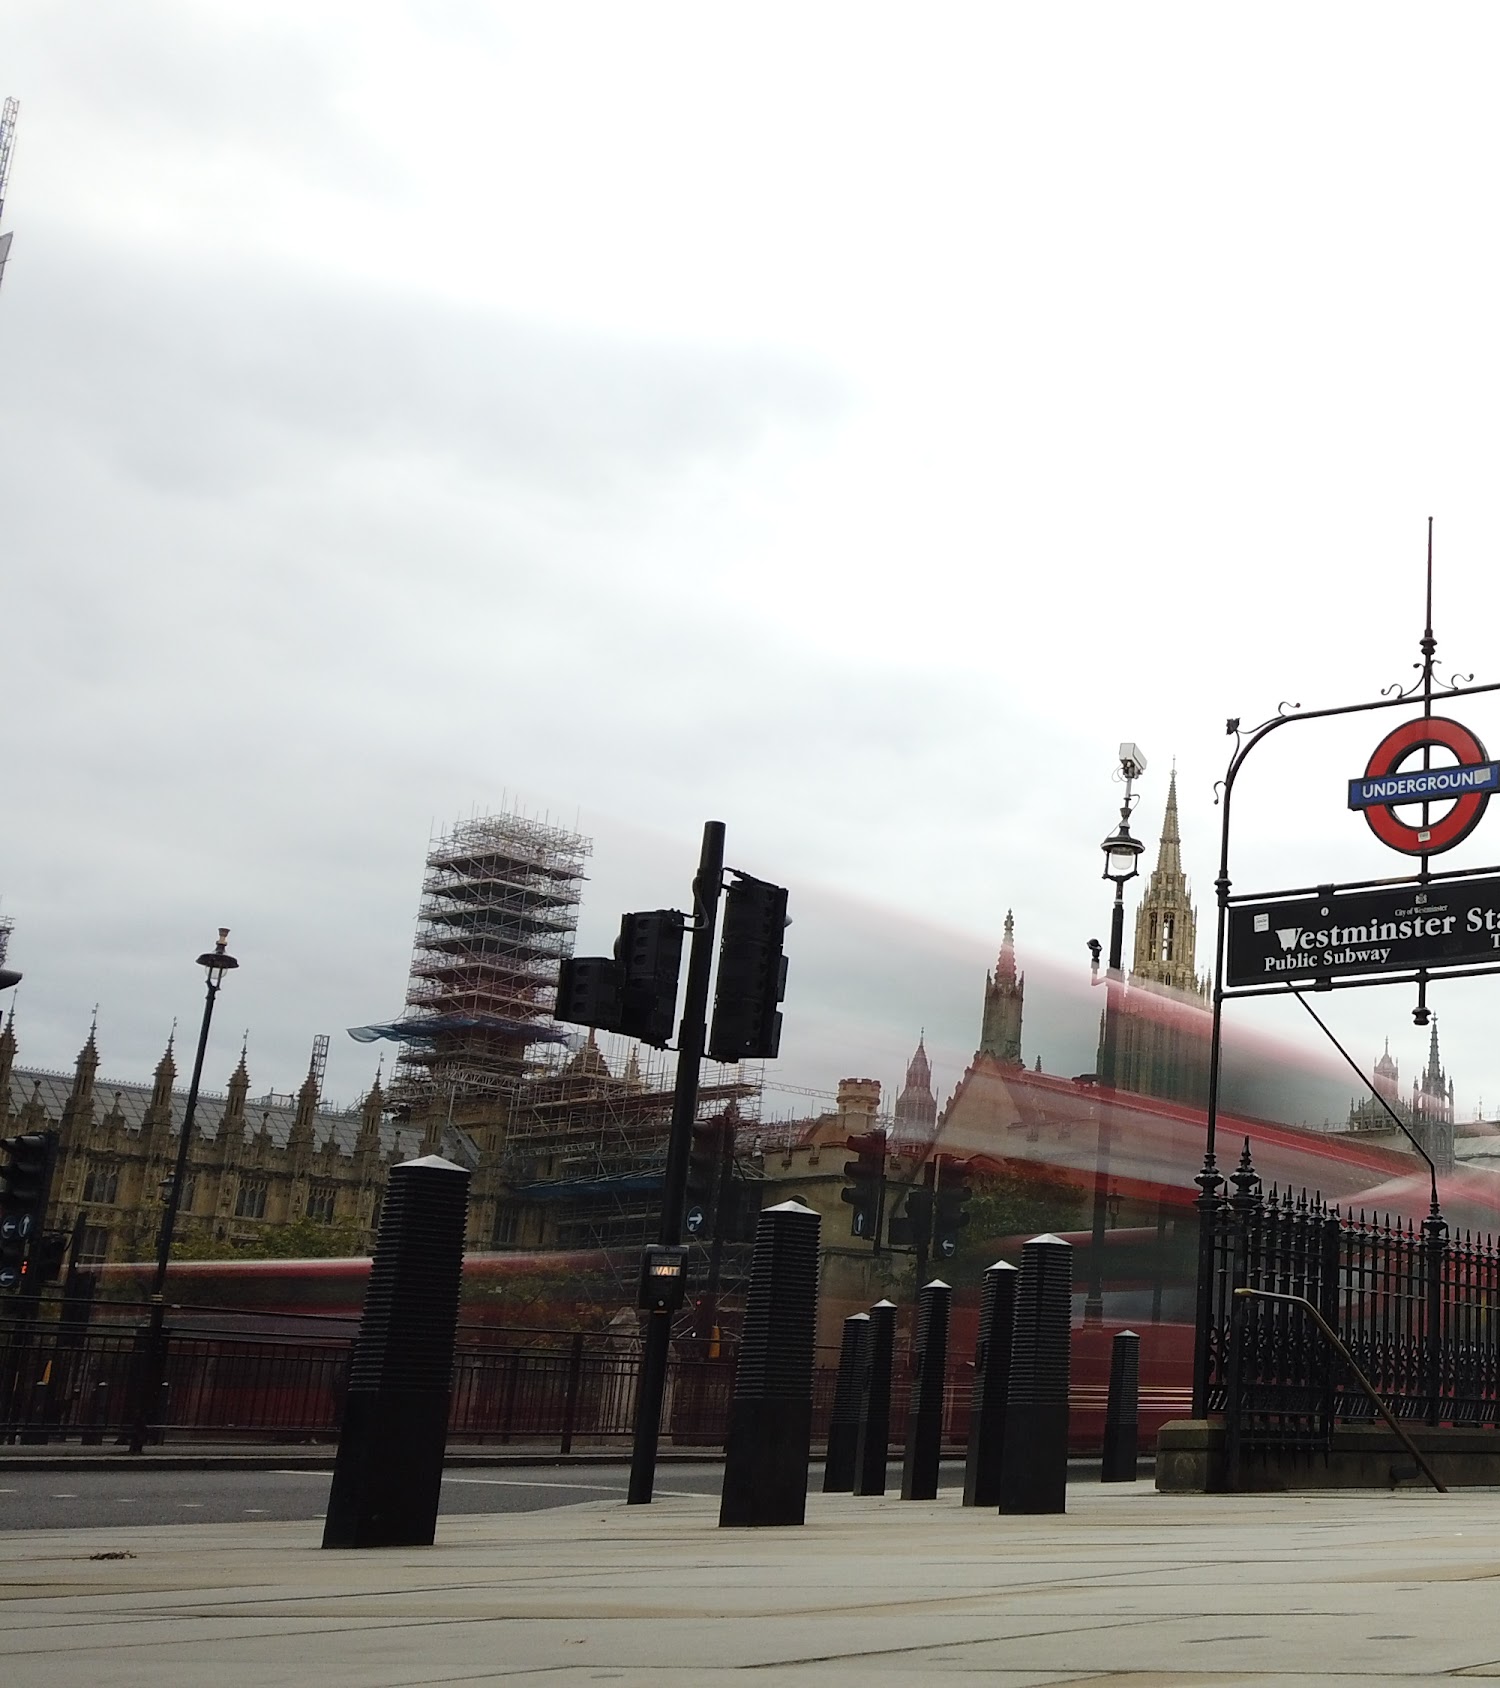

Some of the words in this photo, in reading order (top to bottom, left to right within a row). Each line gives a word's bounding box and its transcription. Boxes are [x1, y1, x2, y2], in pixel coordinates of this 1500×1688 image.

[1362, 770, 1489, 798] UNDERGROUN
[1264, 953, 1318, 971] Public
[1323, 947, 1391, 966] Subway
[651, 1266, 680, 1276] WAIT
